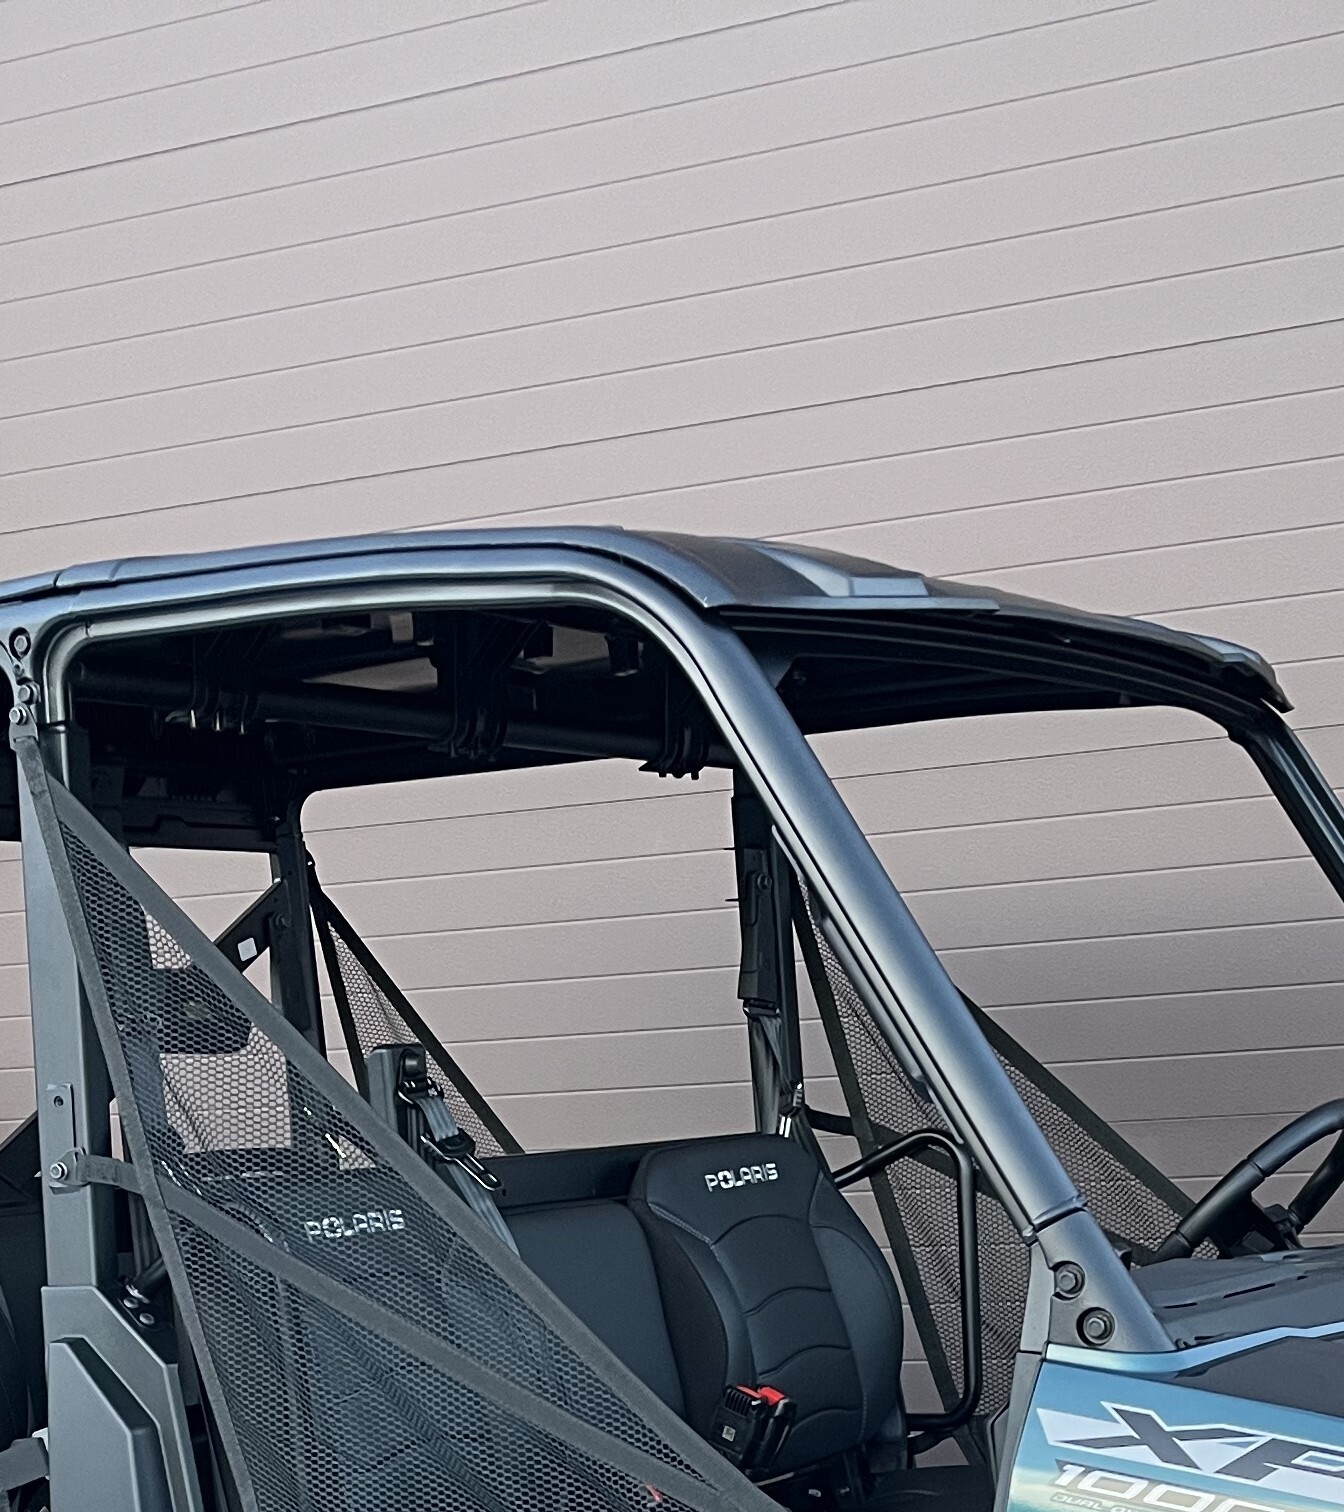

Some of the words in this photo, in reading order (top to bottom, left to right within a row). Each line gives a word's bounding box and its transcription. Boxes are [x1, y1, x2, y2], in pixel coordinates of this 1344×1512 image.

[704, 1163, 779, 1192] POLARIS
[304, 1209, 406, 1243] POLARIS
[1052, 1493, 1106, 1511] DUAL
